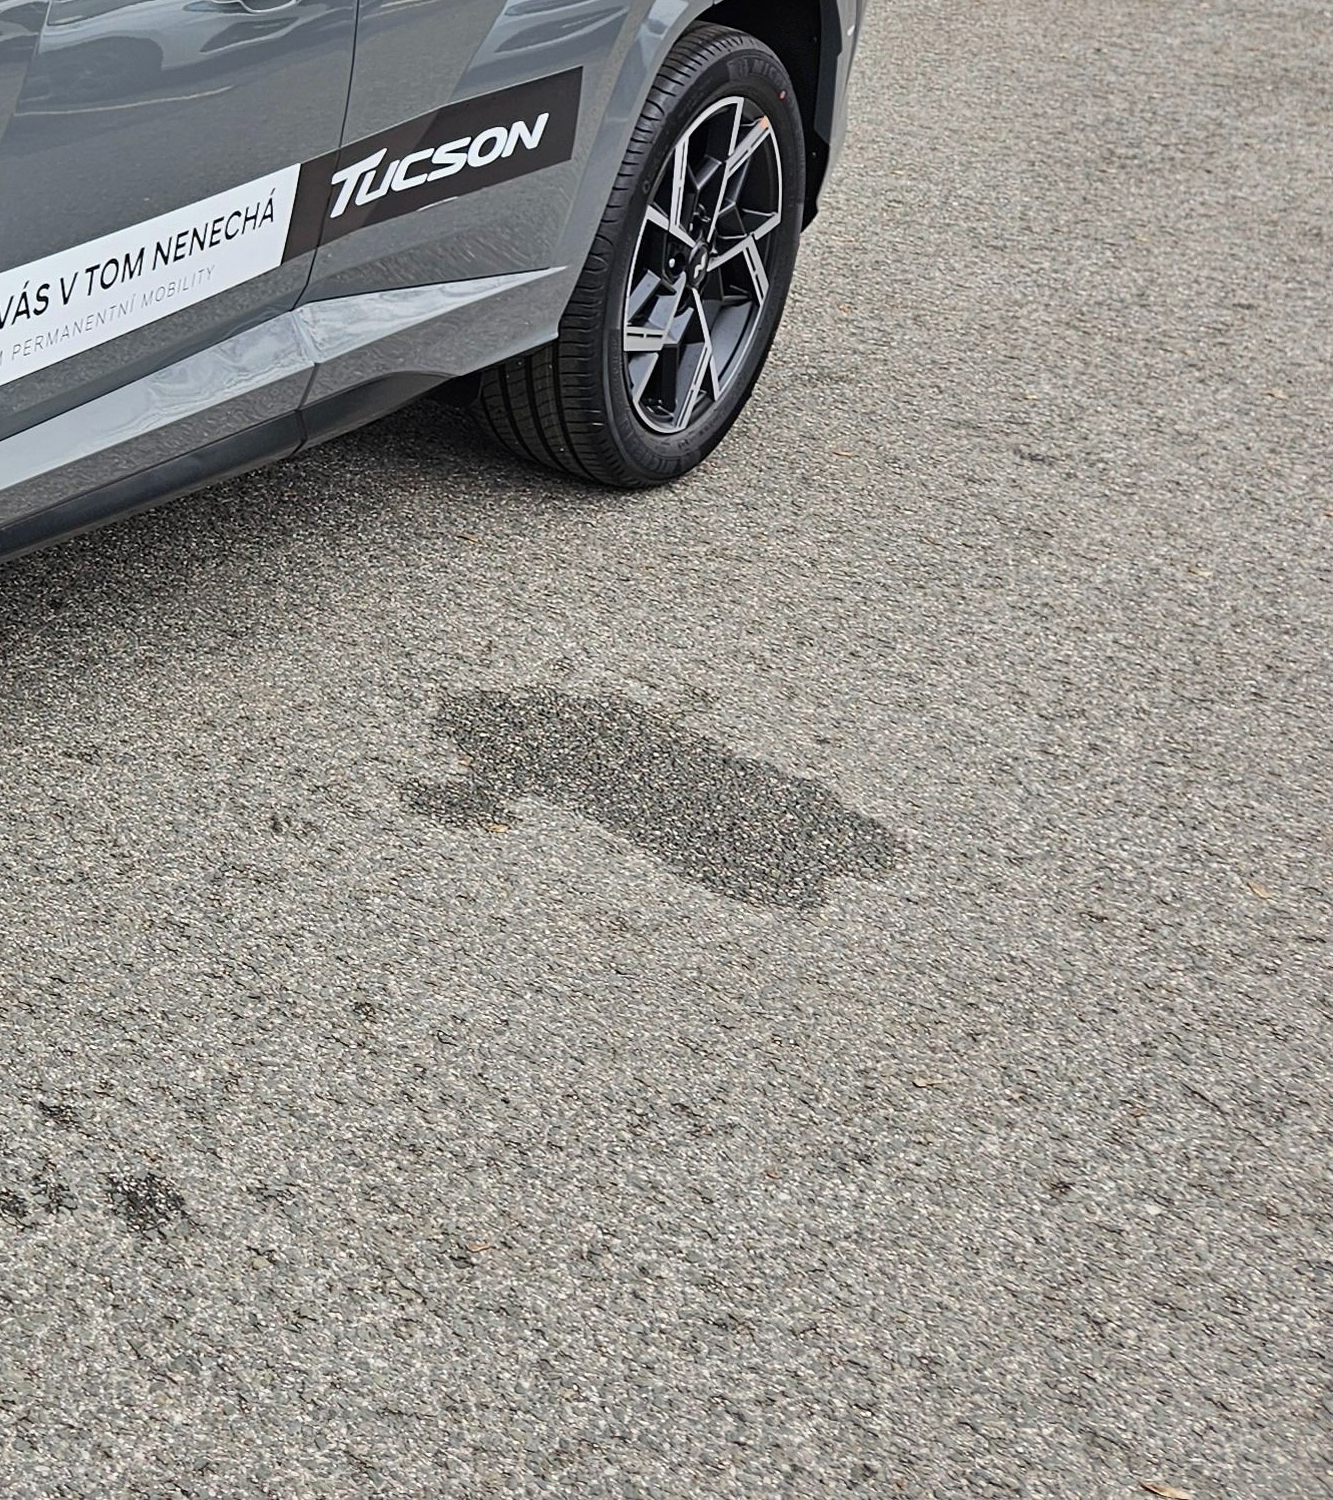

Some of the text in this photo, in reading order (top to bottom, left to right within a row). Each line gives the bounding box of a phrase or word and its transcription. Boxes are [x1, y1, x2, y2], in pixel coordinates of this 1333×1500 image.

[329, 111, 550, 219] TUCSON
[59, 274, 81, 307] V
[85, 247, 146, 297] TOM
[151, 187, 277, 272] NENECHÁ
[10, 291, 138, 363] PERMANENTNÍ
[140, 263, 218, 310] MOBILITY
